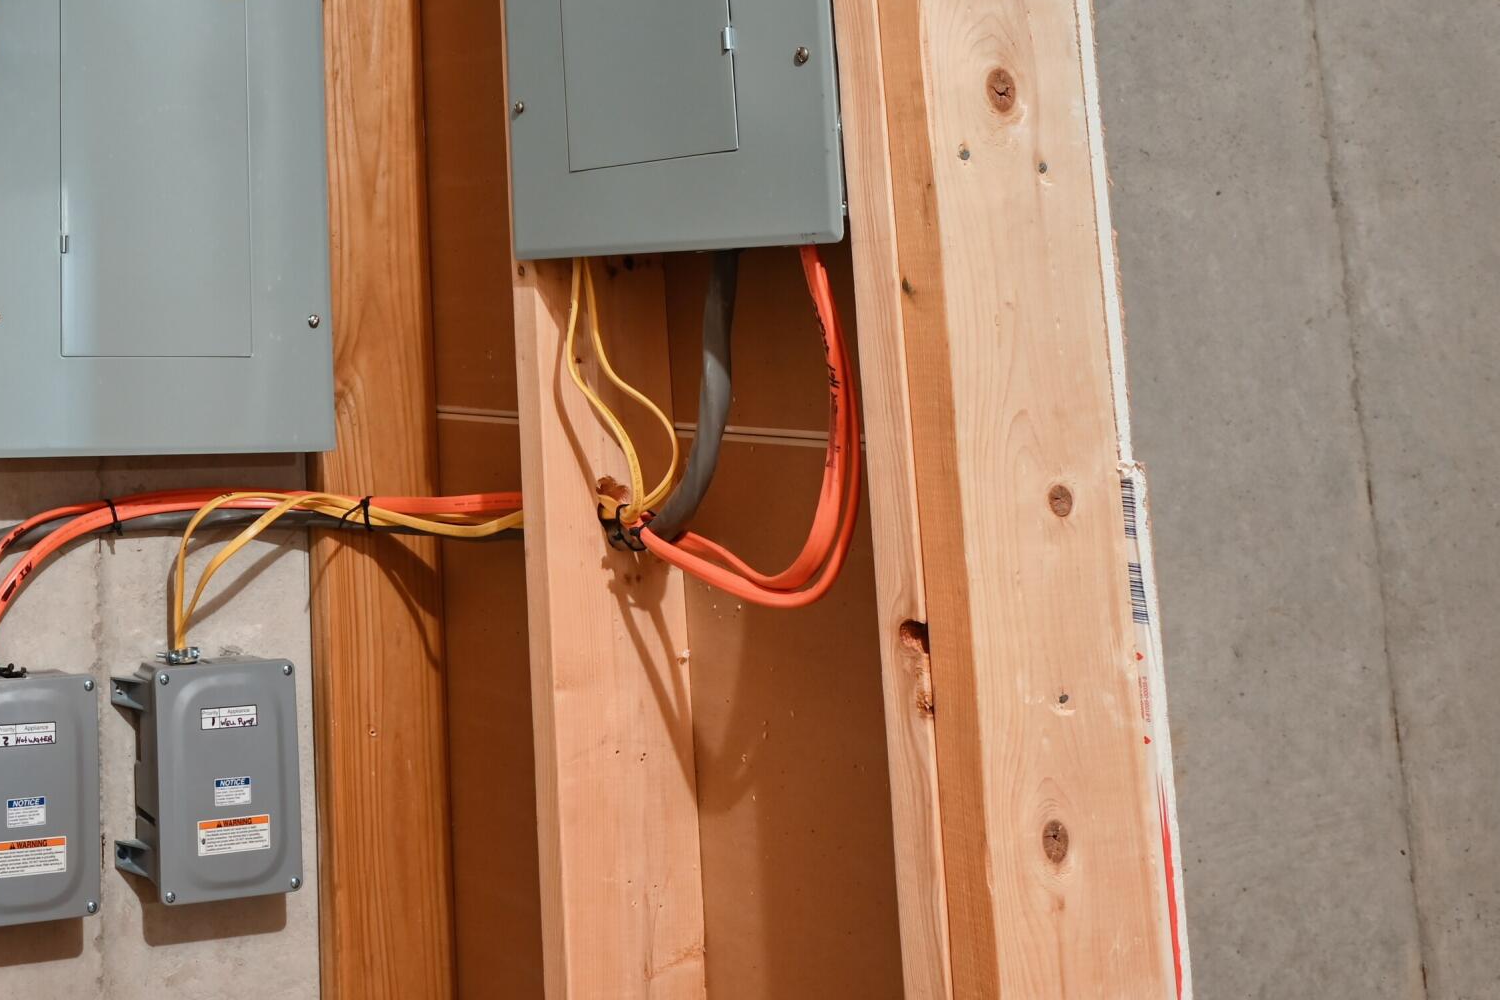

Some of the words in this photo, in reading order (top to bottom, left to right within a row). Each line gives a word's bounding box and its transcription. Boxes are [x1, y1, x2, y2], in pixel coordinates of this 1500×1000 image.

[219, 778, 245, 787] NOTICE
[12, 798, 40, 807] NOTICE
[222, 817, 252, 827] WARNING
[16, 839, 48, 849] WARNING
